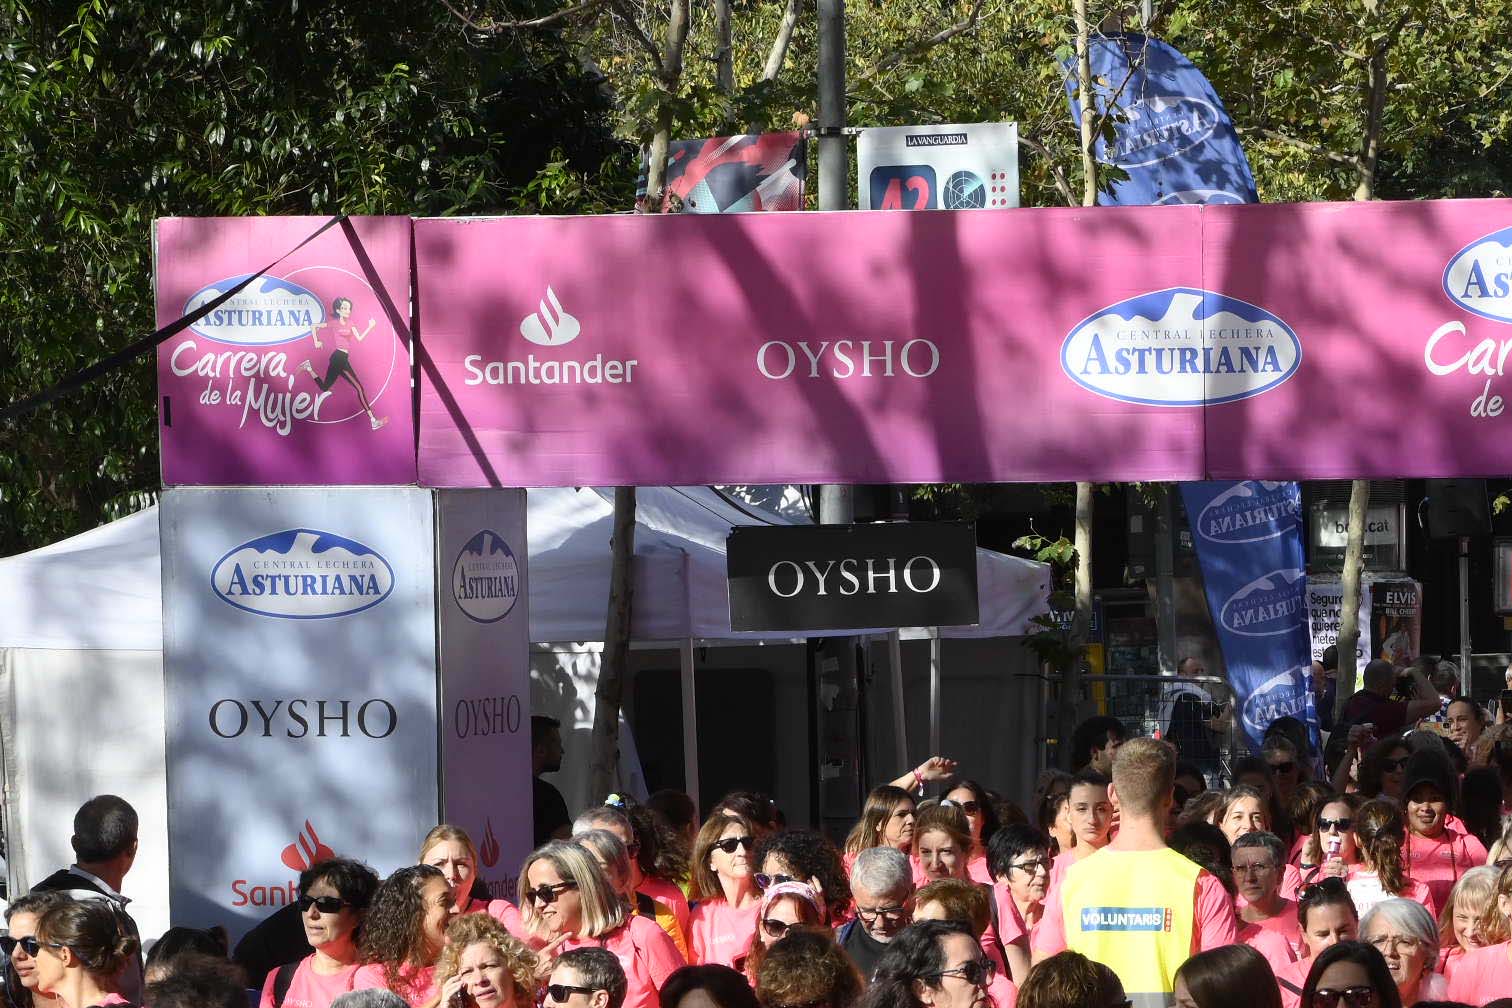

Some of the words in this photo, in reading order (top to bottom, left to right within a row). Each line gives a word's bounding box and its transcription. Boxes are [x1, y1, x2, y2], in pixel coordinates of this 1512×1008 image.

[196, 300, 313, 327] ASTURIANA
[1117, 328, 1191, 341] CENTRAL
[1200, 327, 1274, 340] LECHERA
[170, 341, 288, 378] Carrera
[464, 353, 638, 385] Santander
[756, 338, 940, 380] OYSHO
[1080, 333, 1283, 376] ASTURIANA
[200, 380, 221, 405] de
[227, 380, 242, 405] la
[240, 375, 332, 436] Mujer
[1470, 380, 1504, 417] de
[225, 563, 381, 597] ASTURIANA
[253, 560, 311, 570] CENTRAL
[317, 559, 375, 569] LECHERA
[767, 555, 941, 598] OYSHO
[458, 565, 516, 600] ASTURIANA
[1386, 591, 1416, 604] ELVIS
[1311, 609, 1327, 621] que
[208, 698, 398, 738] OYSHO
[455, 694, 521, 739] OYSHO
[1082, 913, 1161, 926] VOLUNTARIS
